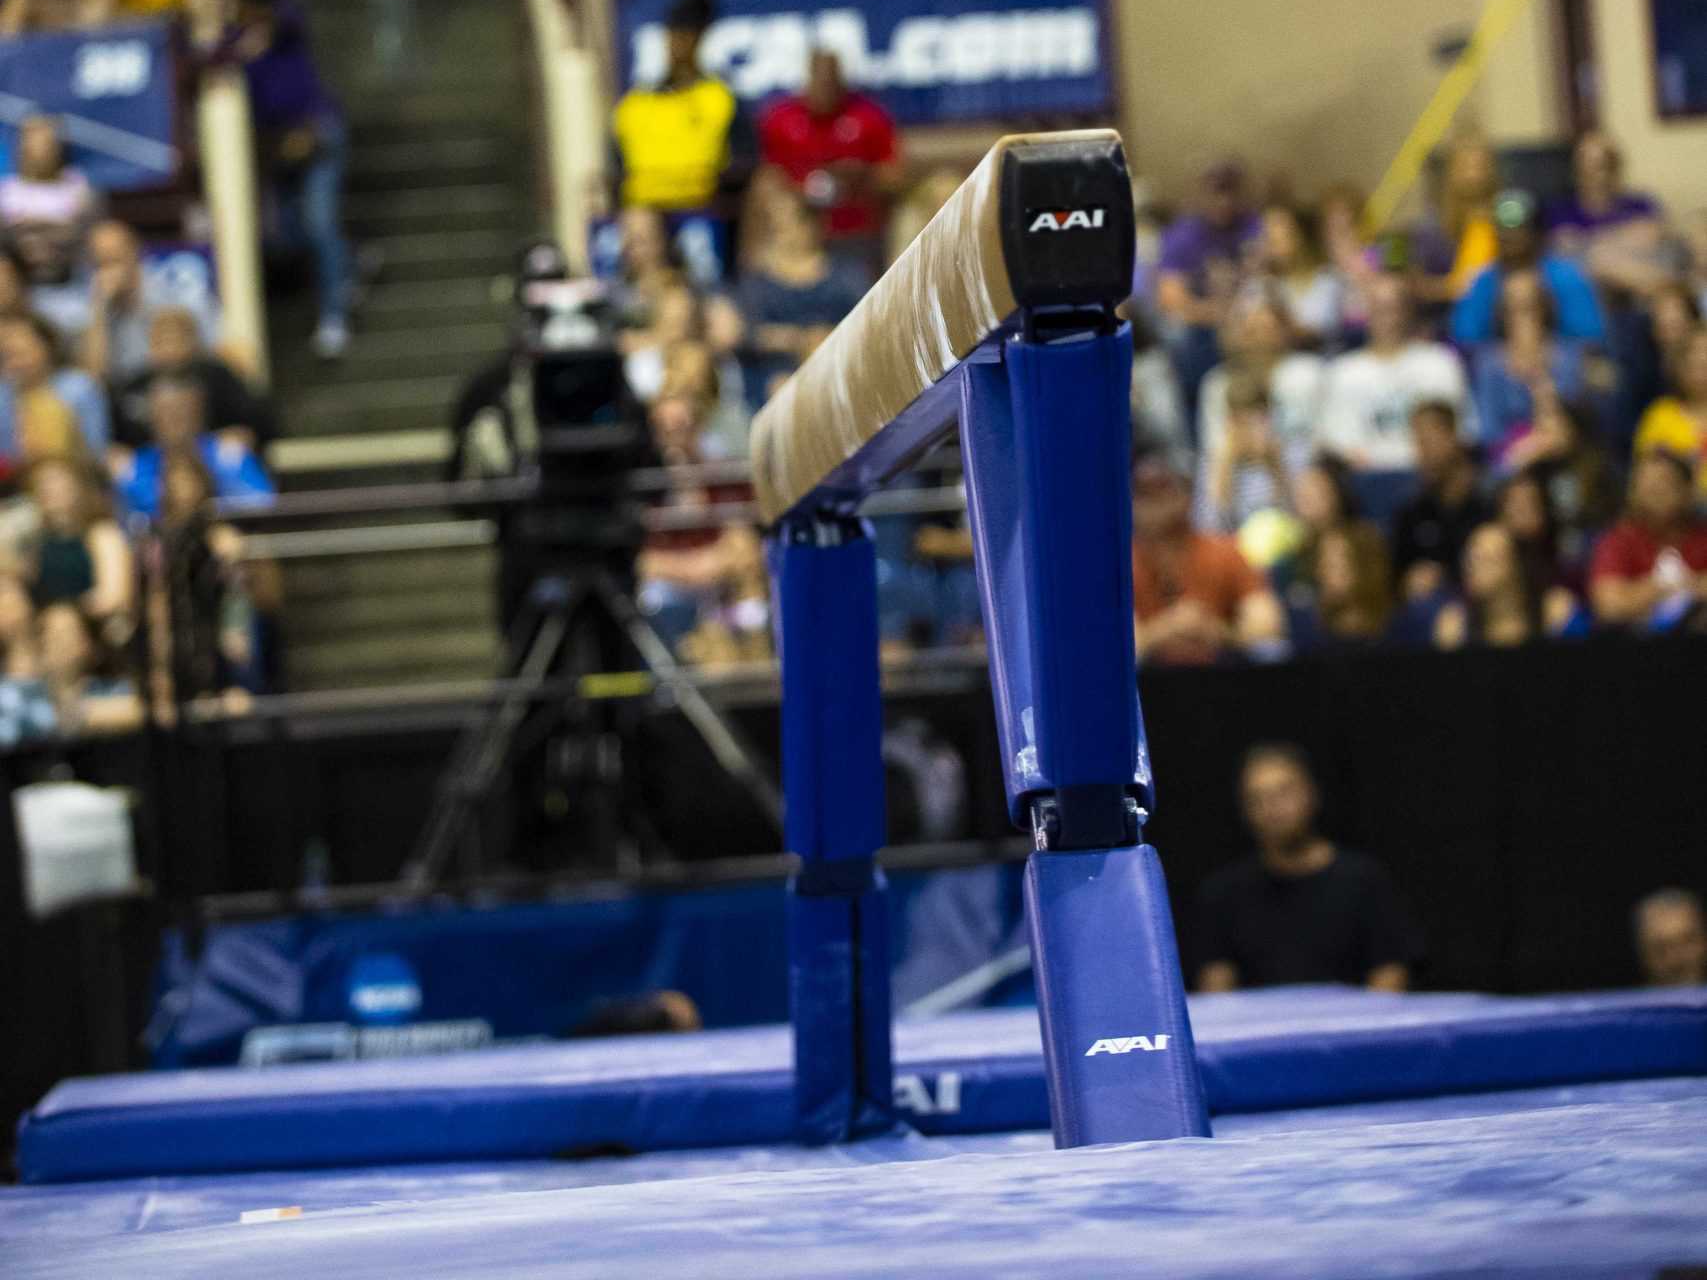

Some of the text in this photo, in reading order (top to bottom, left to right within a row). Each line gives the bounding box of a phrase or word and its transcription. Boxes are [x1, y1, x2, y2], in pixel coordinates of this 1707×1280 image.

[1029, 208, 1104, 232] AAI
[1084, 1034, 1170, 1056] AAI
[891, 1073, 960, 1112] AI
